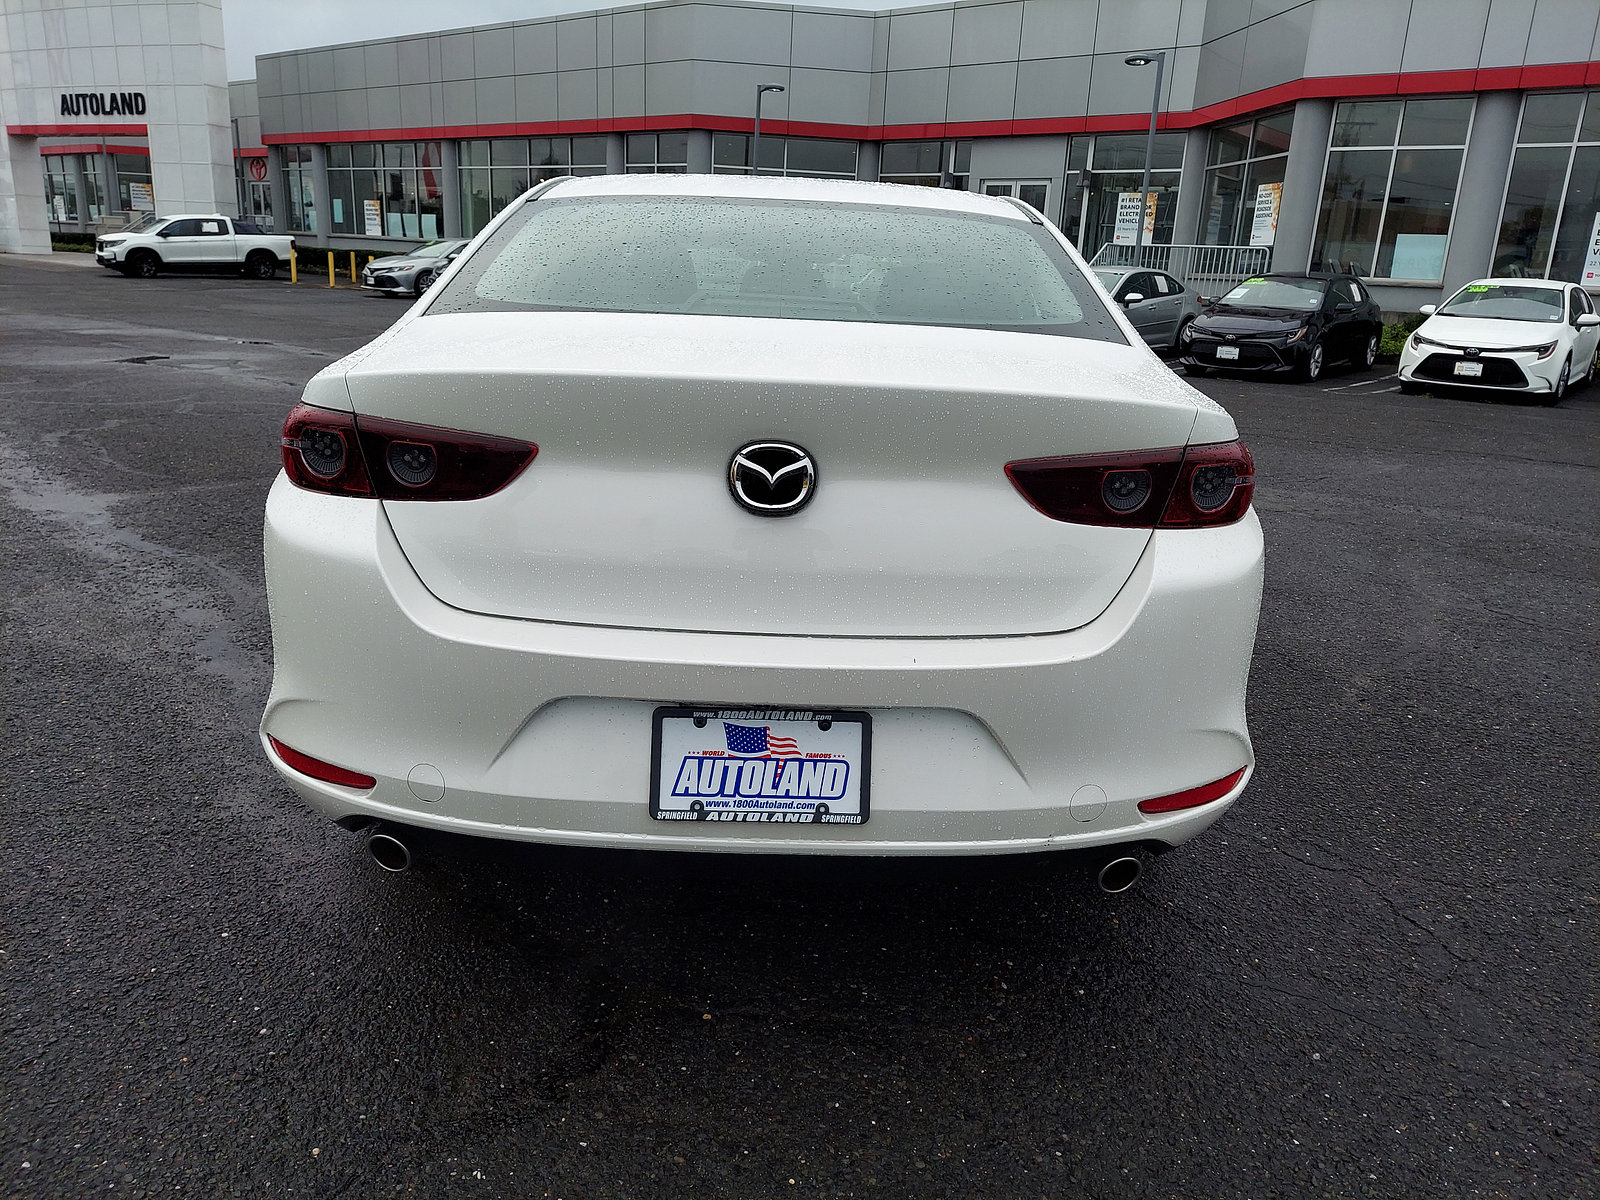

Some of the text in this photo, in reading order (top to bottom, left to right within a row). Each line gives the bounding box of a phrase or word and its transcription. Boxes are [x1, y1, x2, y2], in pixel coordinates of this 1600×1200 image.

[60, 92, 146, 116] AUTOLAND
[693, 710, 832, 721] www.1800AUTOLAND.com
[671, 756, 850, 800] AUTOLAND
[705, 799, 816, 810] www.1800Autoland.com
[656, 811, 862, 824] SPRINGFIELD AUTOLAND SPRINGFIELD
